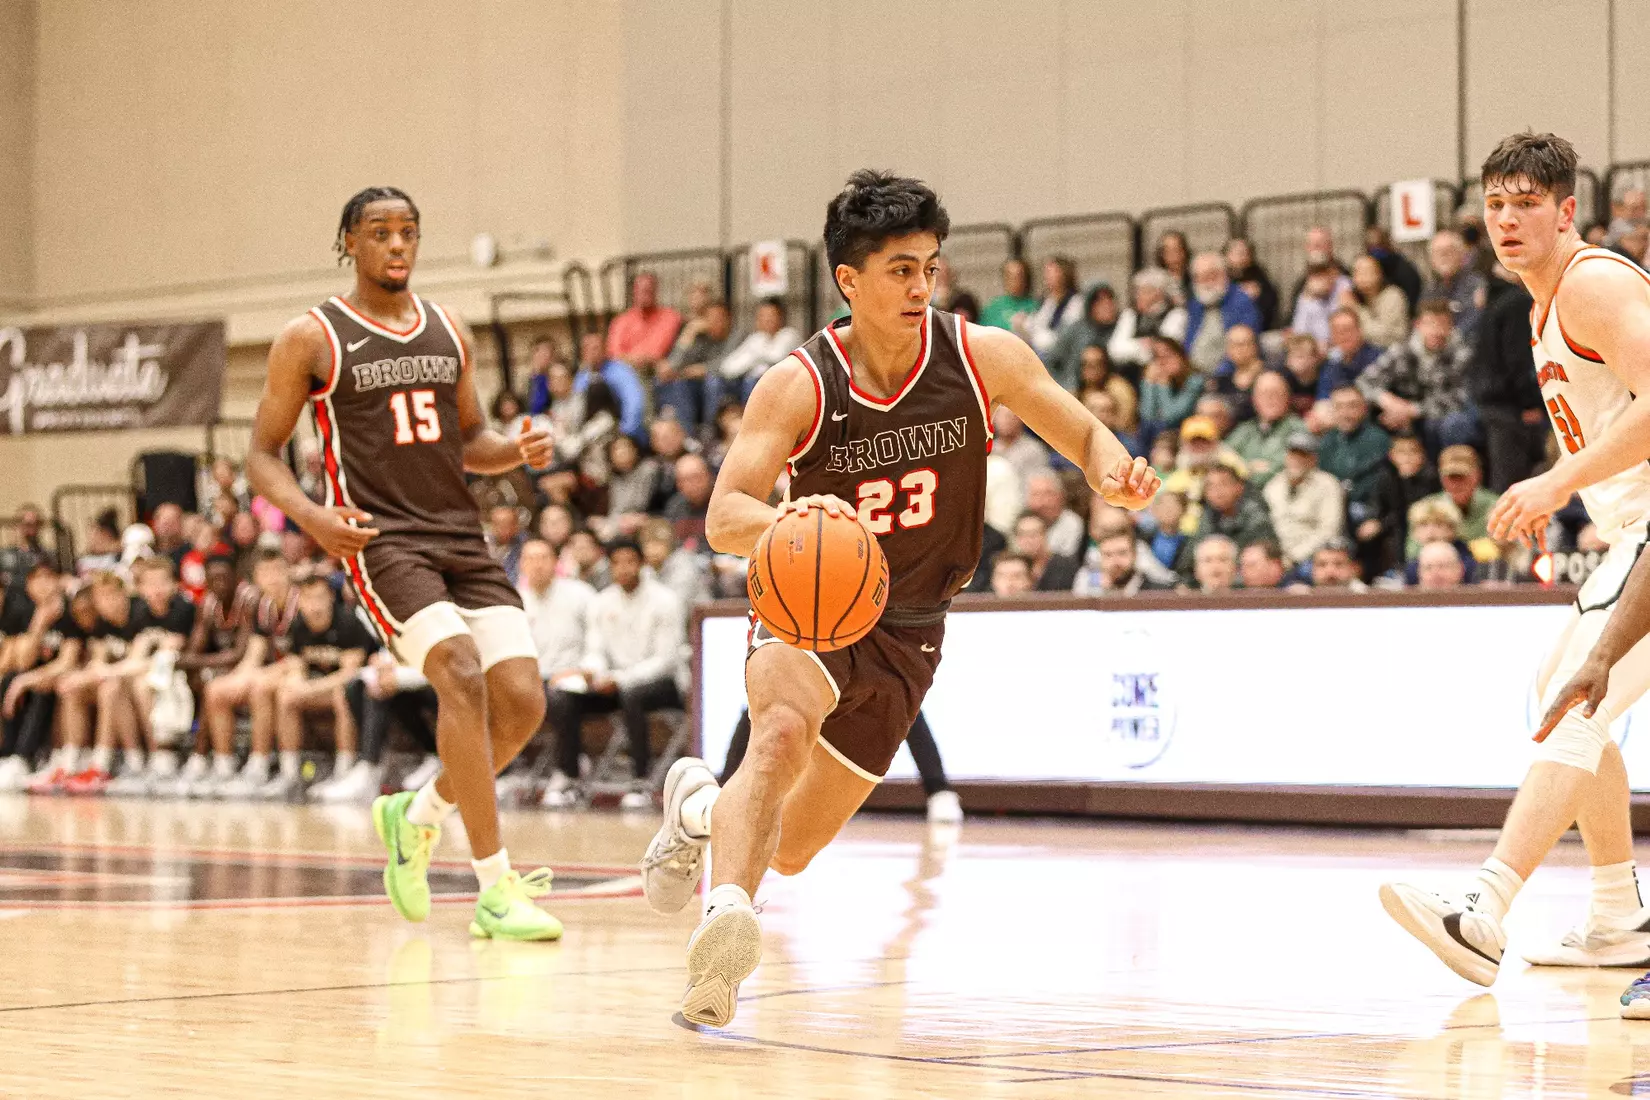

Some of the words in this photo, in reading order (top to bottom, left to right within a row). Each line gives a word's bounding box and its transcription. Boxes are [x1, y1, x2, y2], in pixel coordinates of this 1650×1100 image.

[1401, 193, 1423, 227] L
[352, 355, 458, 393] BROWN
[390, 389, 441, 445] 15
[825, 416, 968, 473] BROWN
[856, 467, 939, 536] 23
